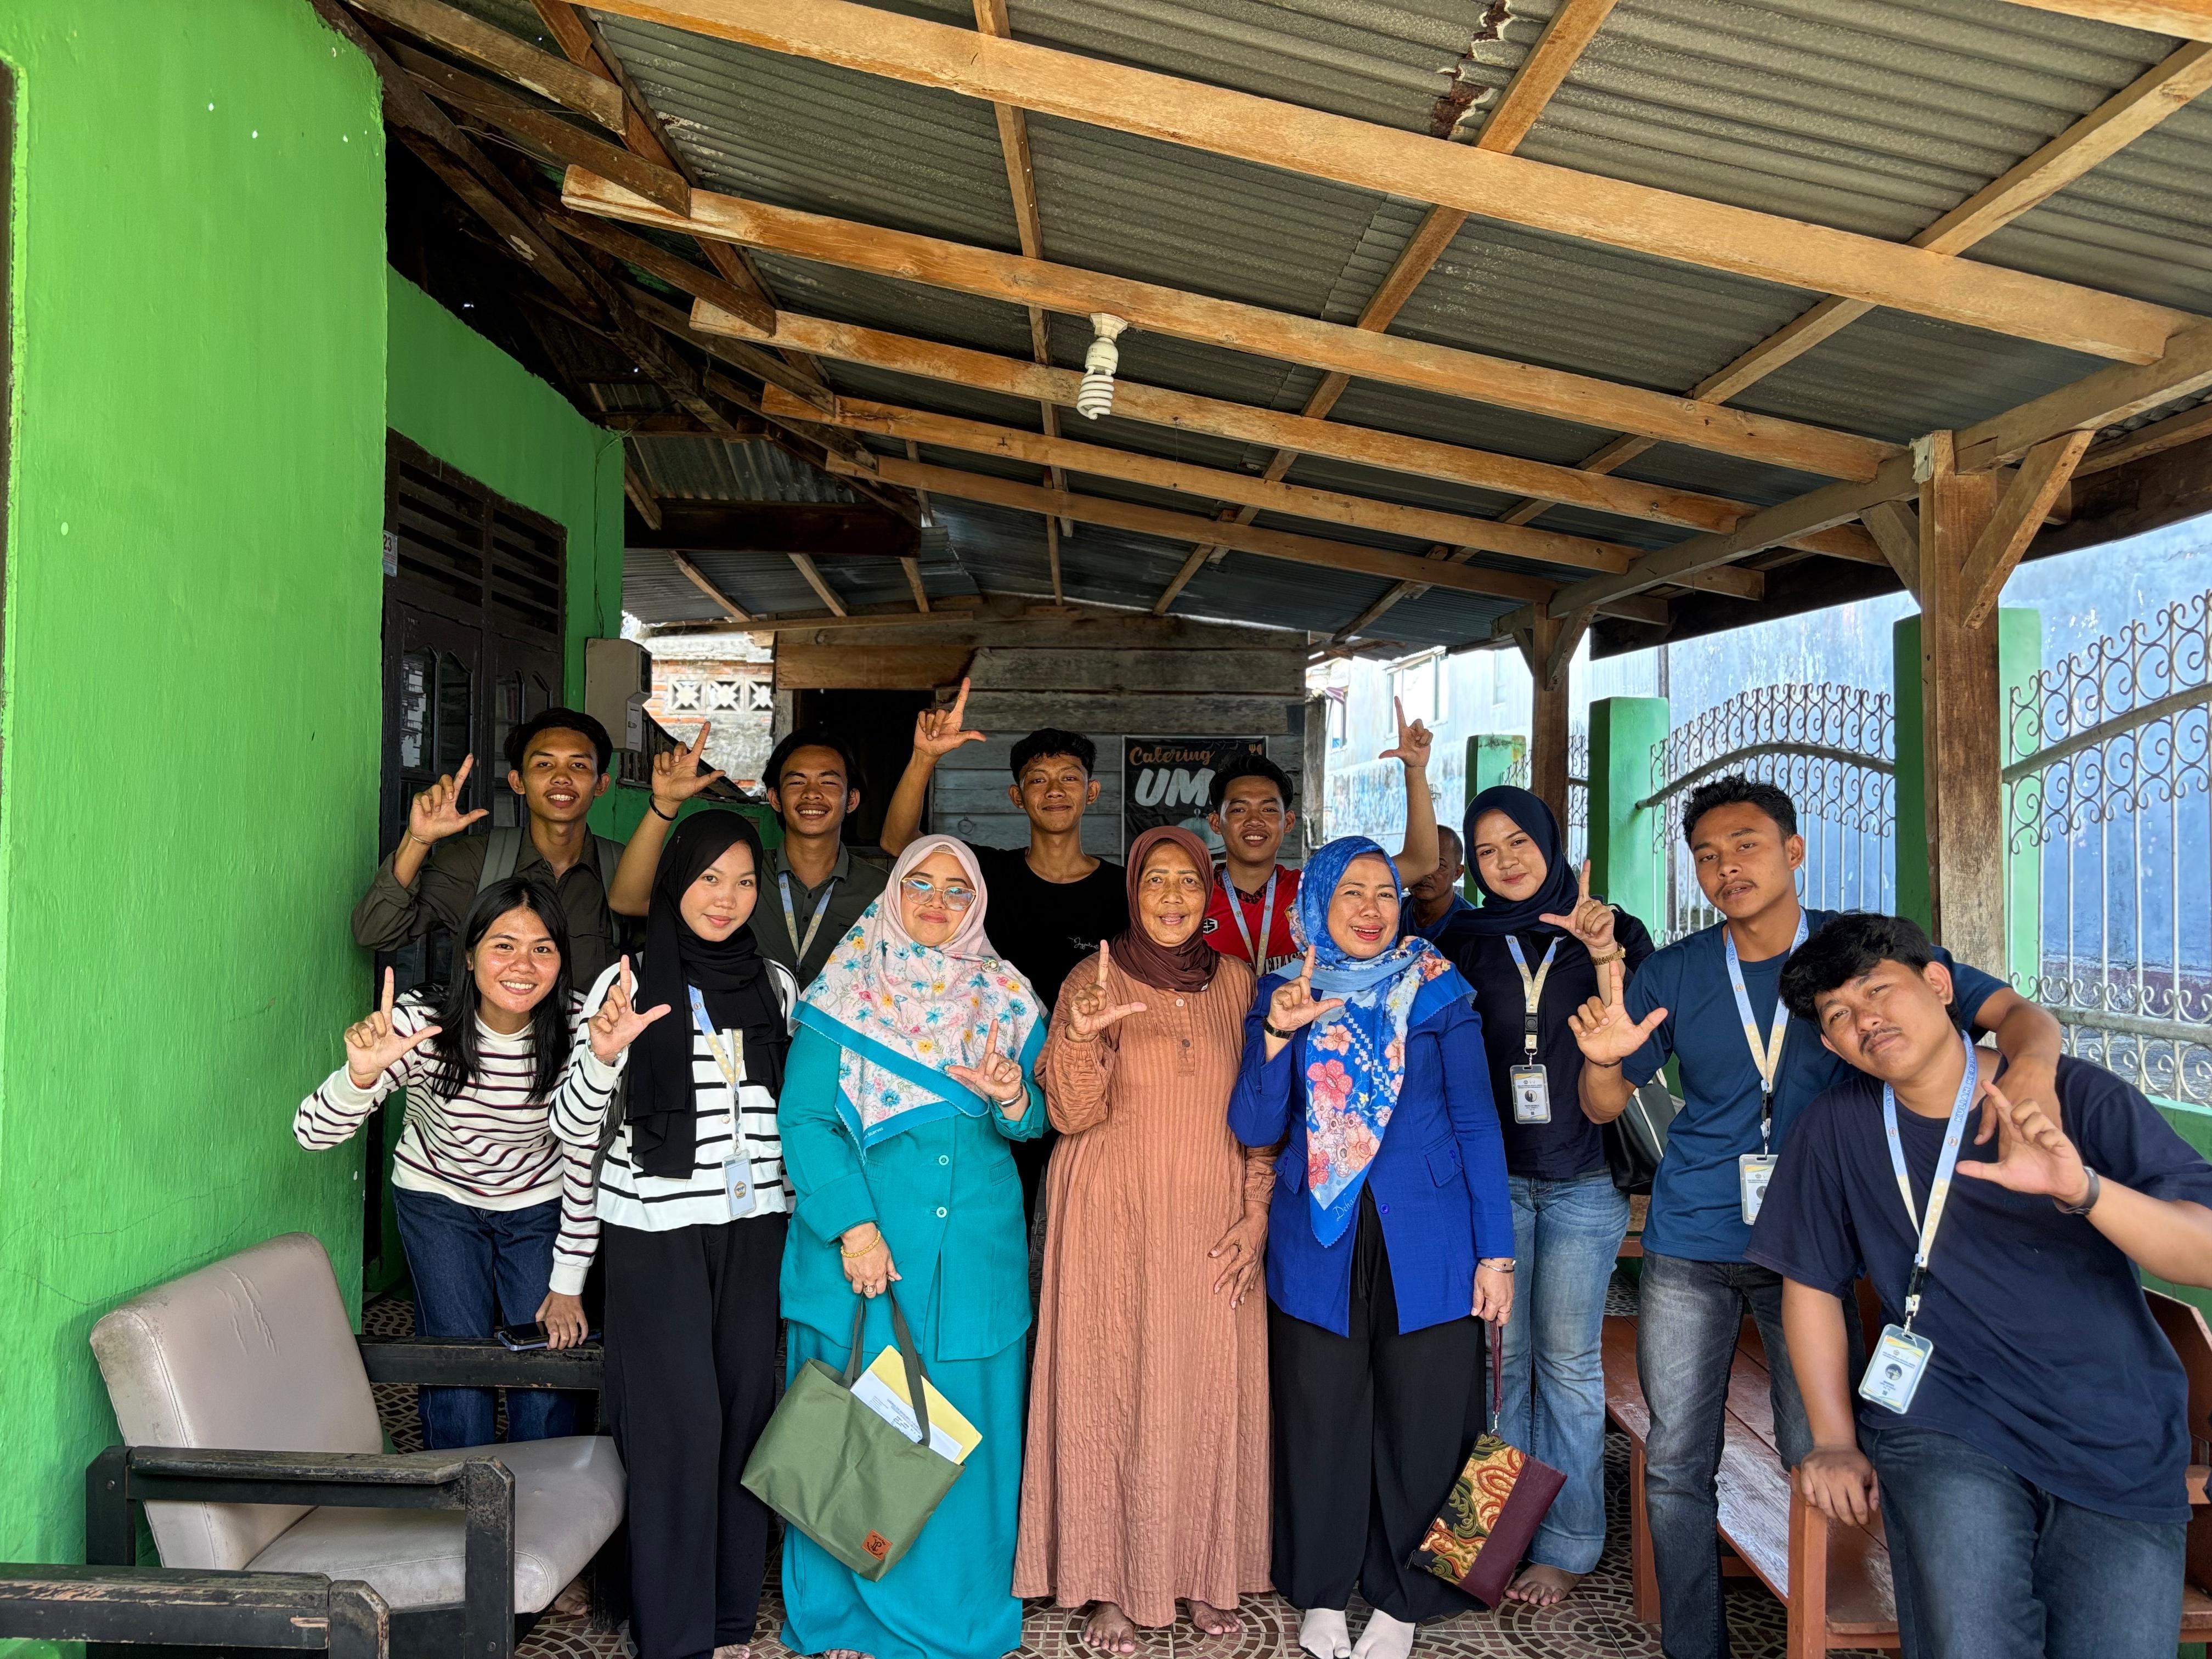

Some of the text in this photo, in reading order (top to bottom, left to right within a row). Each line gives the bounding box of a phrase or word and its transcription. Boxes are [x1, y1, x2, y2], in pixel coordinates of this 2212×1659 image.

[1129, 747, 1216, 766] Catering
[1135, 768, 1216, 807] UM
[1954, 1087, 1971, 1122] KULIAH
[1966, 1057, 1976, 1085] KERJA
